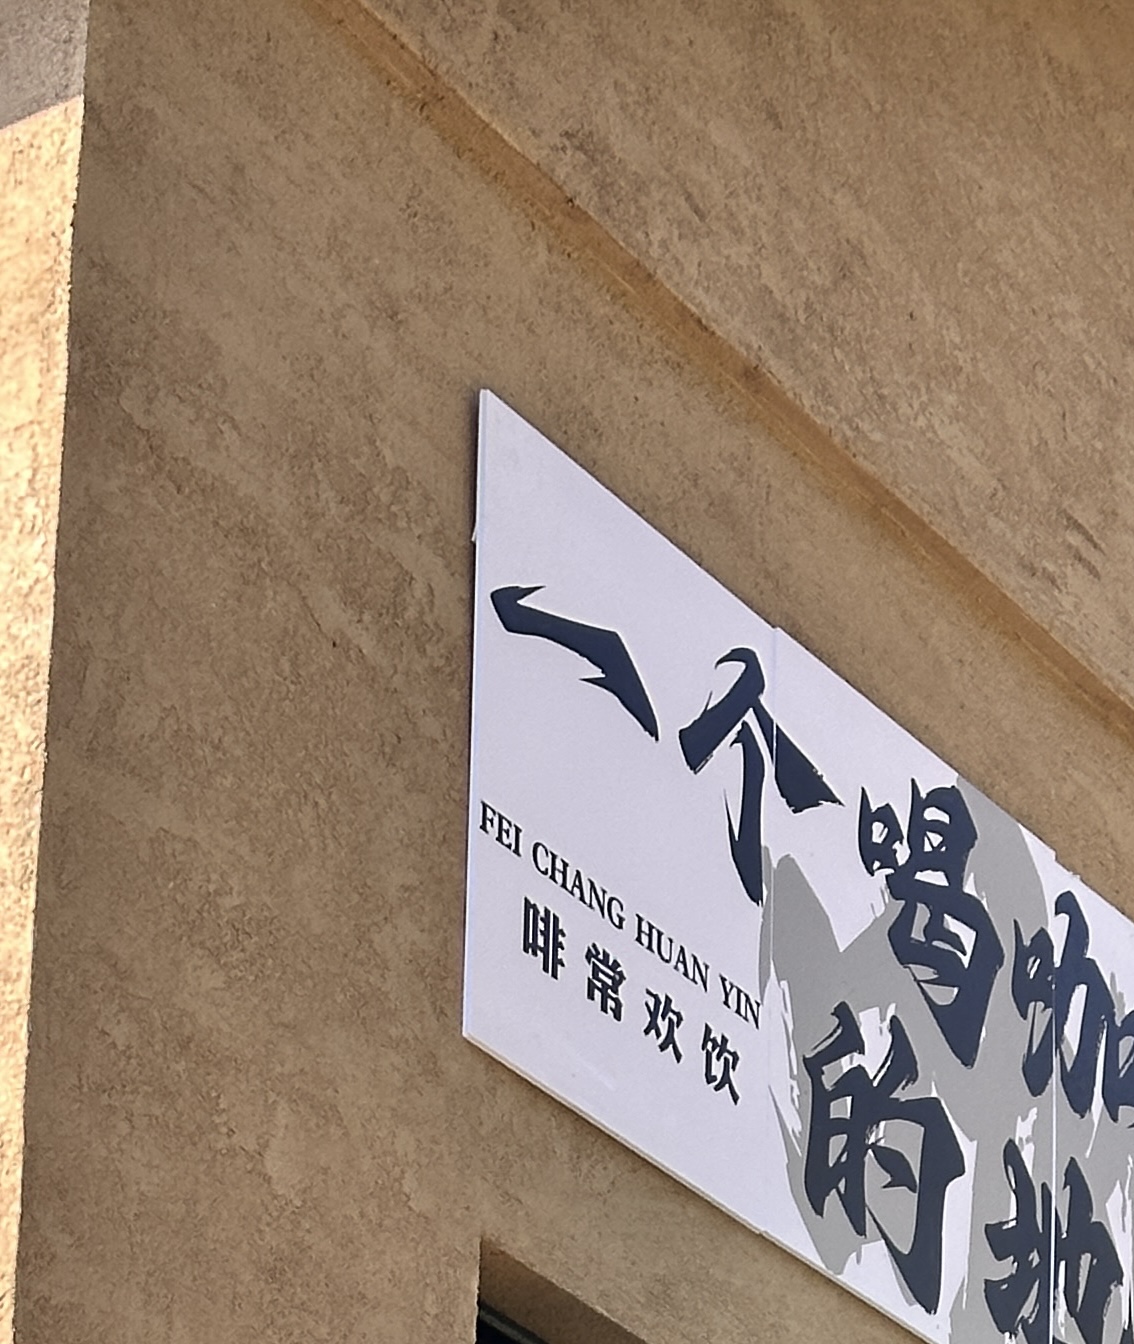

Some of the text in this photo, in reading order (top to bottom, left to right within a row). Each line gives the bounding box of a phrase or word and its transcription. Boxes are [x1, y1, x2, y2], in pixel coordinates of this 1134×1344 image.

[480, 799, 761, 1031] FEI CHANG HUAN YIN
[522, 896, 740, 1106] 啡常欢饮
